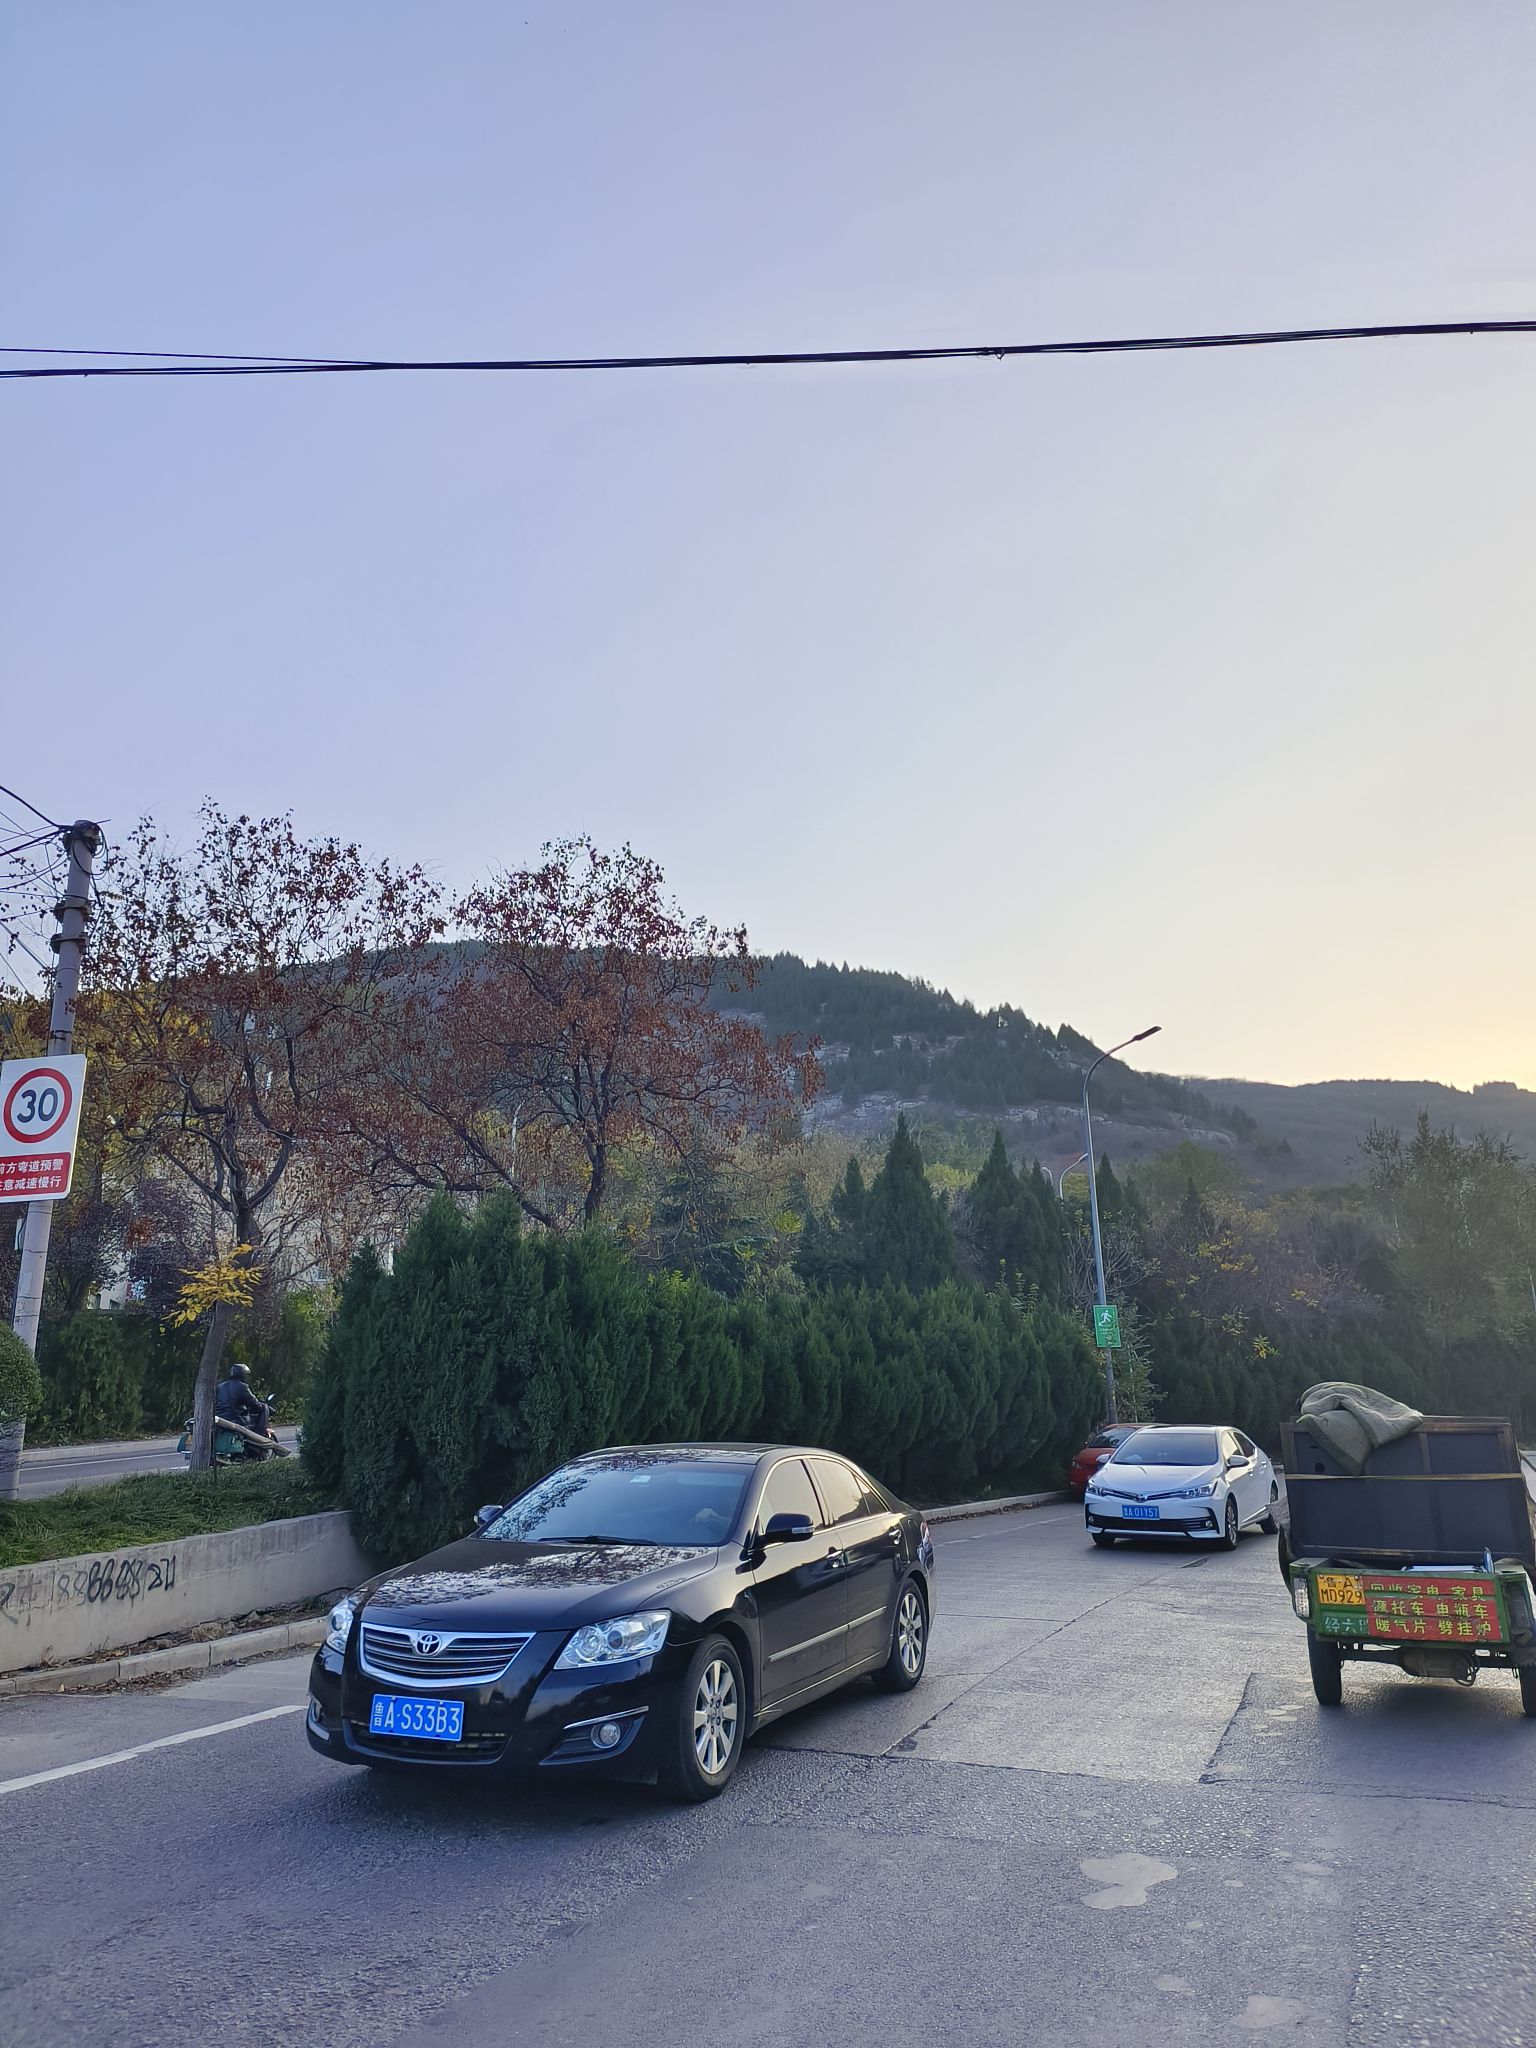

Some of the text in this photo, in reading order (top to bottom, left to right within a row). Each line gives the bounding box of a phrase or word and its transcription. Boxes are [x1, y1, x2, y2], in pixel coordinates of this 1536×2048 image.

[17, 1088, 58, 1122] 30
[0, 1176, 62, 1191] 意减速慢行
[1320, 1588, 1363, 1603] MD929
[1437, 1602, 1489, 1619] 电瓶车
[1375, 1617, 1427, 1634] 暖气片
